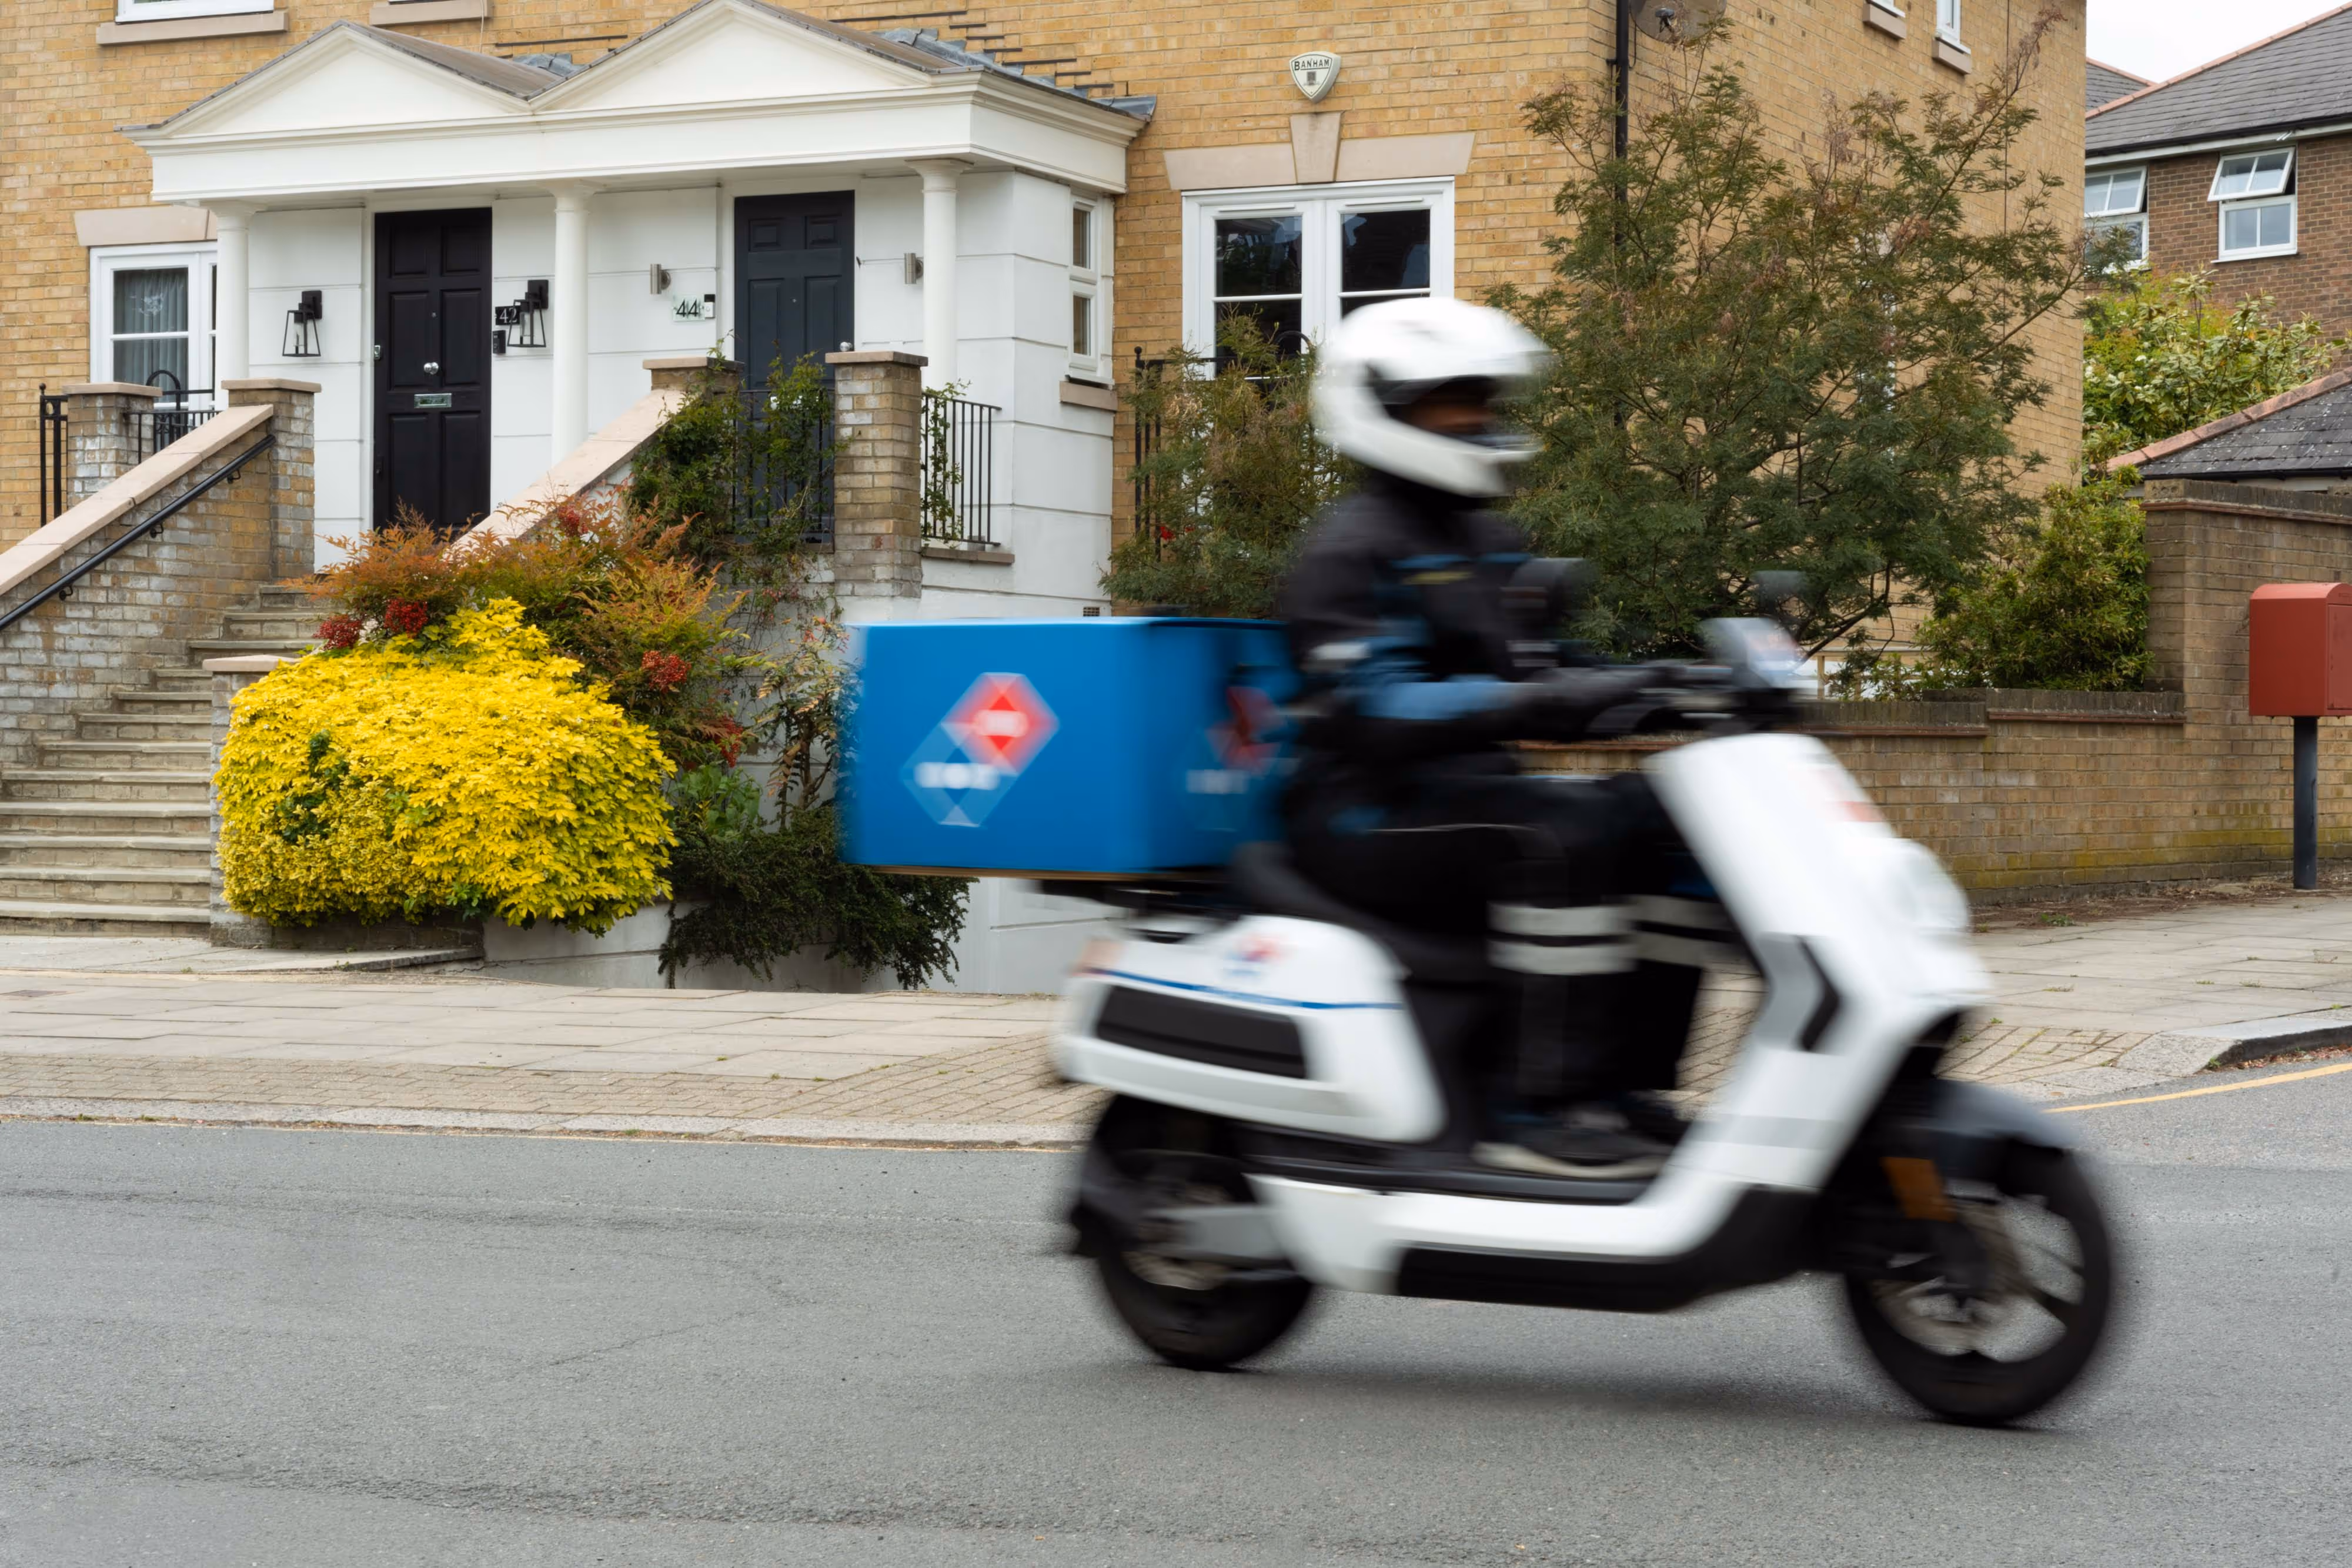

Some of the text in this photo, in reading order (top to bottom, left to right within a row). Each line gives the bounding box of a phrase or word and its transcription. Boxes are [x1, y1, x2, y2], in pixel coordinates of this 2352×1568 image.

[1294, 59, 1329, 71] BANHAM
[499, 307, 518, 323] 42
[676, 299, 699, 317] 44
